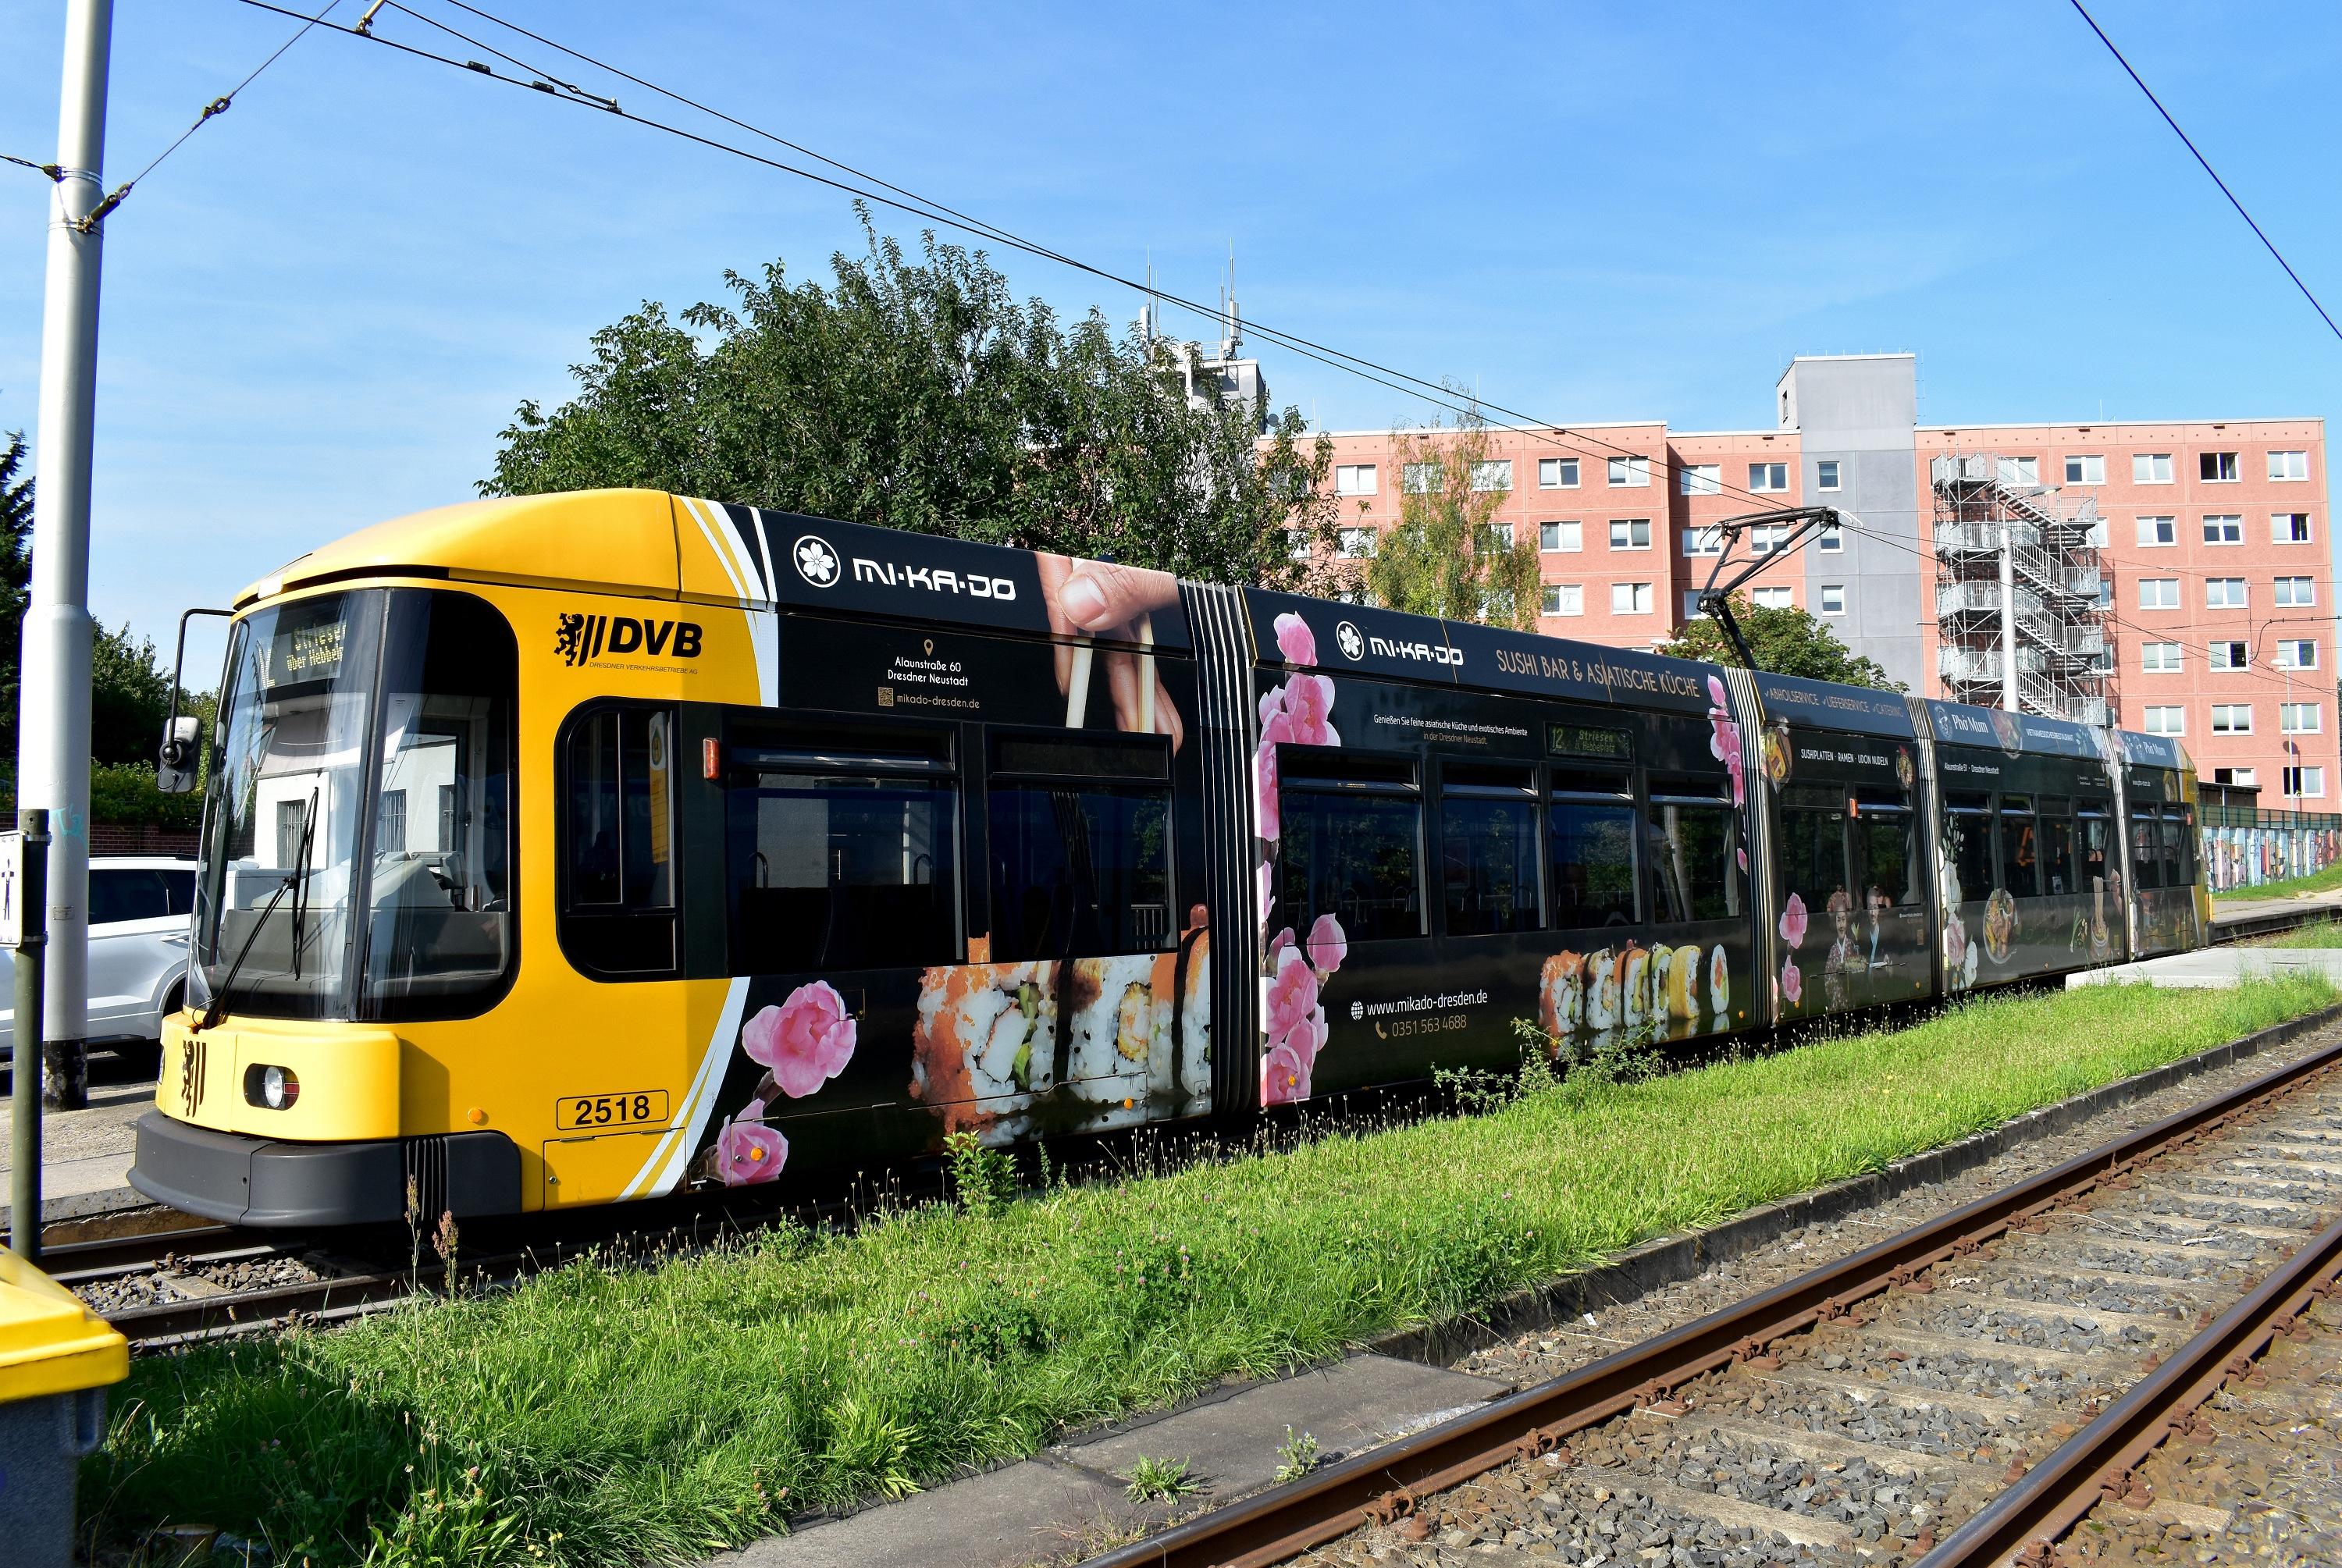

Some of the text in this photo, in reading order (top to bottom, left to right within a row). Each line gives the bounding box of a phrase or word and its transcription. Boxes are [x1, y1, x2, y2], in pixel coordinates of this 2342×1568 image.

[607, 617, 703, 658] DVB
[287, 654, 306, 671] über
[626, 664, 689, 674] VERKEHRSBETRIEBE
[895, 656, 962, 673] Alaunstraße 60
[888, 670, 969, 687] Dresdner Neustadt
[1496, 649, 1700, 698] SUSHI BAR & ASIATISCHE KÜCHE
[896, 693, 981, 709] mikado-dresden.de
[1770, 688, 1903, 718] ABHOLSERVICE LIEFERSERVICE CATERING
[1373, 714, 1528, 736] Genießen Sie feine asiatische Küche und exotisches Ambiente
[1967, 716, 1989, 734] Mum
[1423, 731, 1429, 740] in
[1429, 731, 1439, 741] der
[1439, 732, 1462, 742] Dresdner
[1553, 728, 1563, 748] 12
[1579, 730, 1613, 742] Striesen
[1801, 748, 1888, 766] SUSHIPLATTEN RAMEN UDON NUDELN
[1367, 989, 1488, 1015] www.mikado-dresden.de
[1392, 1015, 1467, 1037] 0351 563 4688
[575, 1094, 650, 1125] 2518
